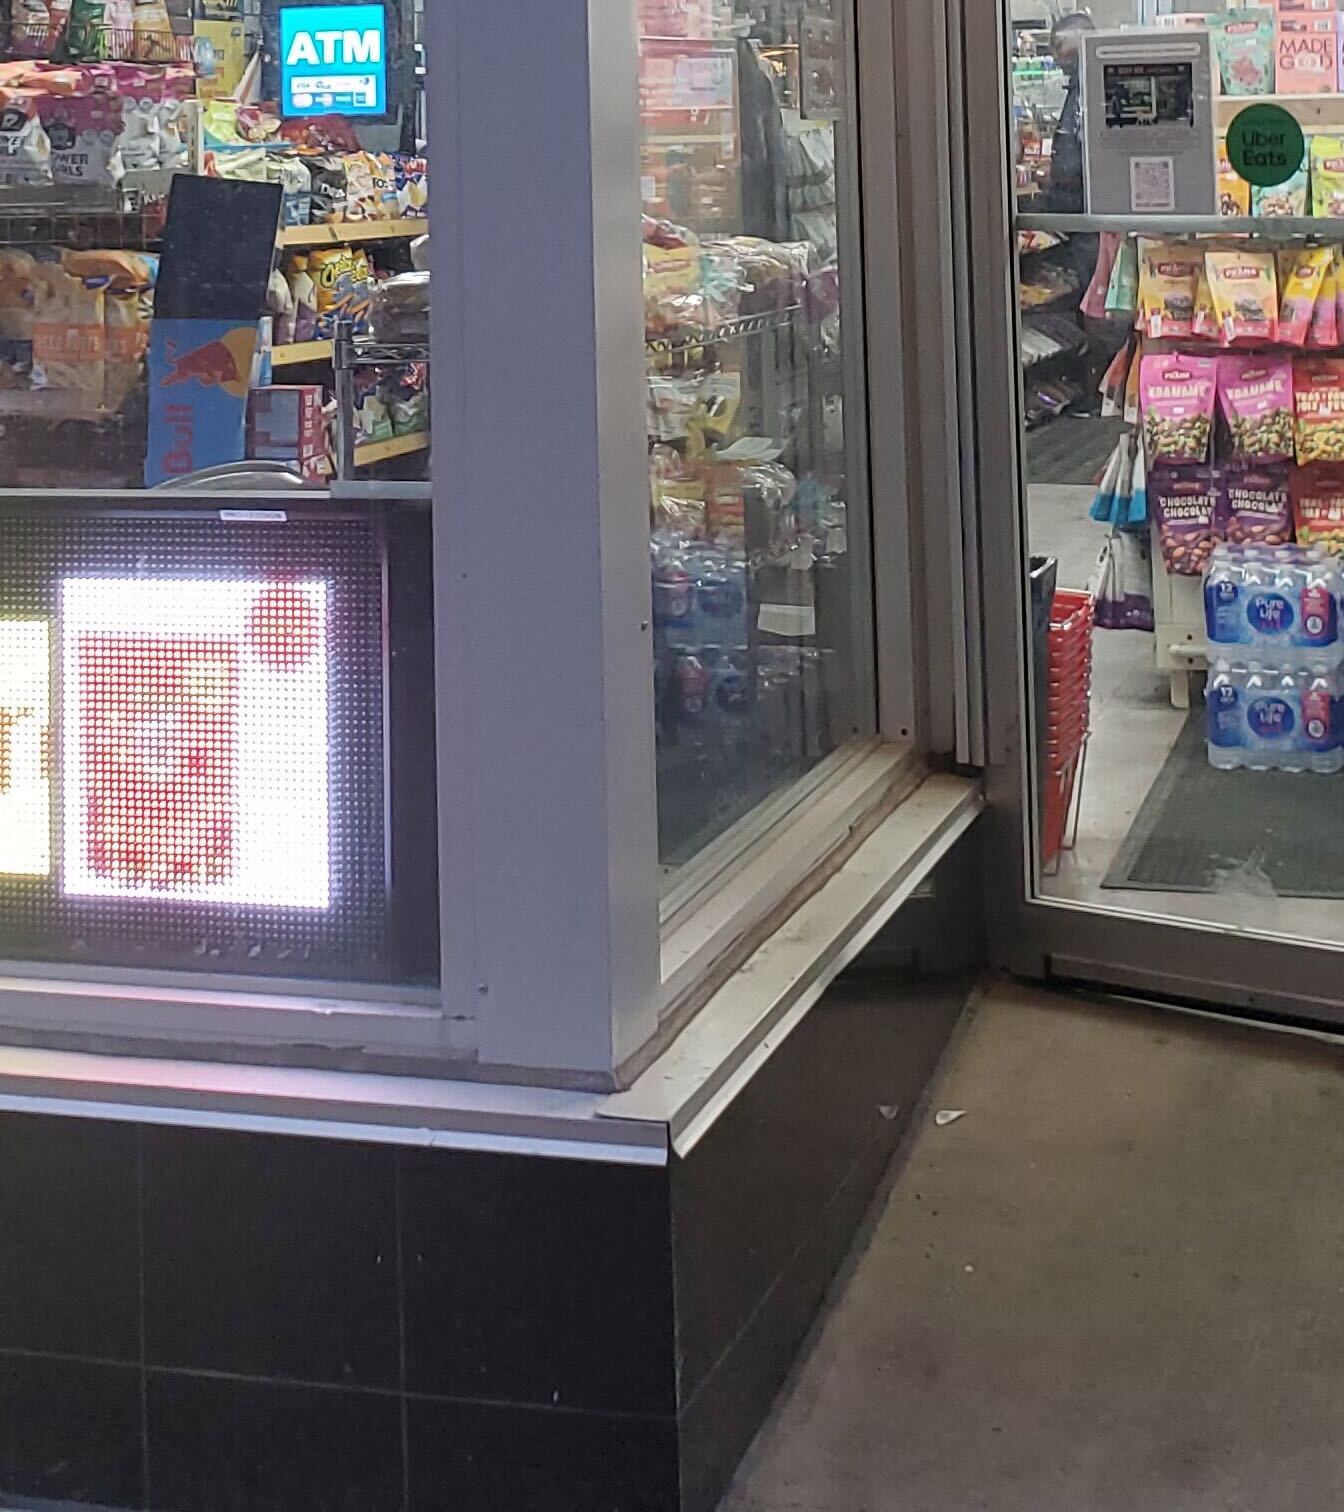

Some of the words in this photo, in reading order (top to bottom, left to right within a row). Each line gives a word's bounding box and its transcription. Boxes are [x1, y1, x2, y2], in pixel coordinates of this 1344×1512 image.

[286, 29, 381, 66] ATM
[1279, 38, 1332, 54] MADE
[1242, 129, 1287, 149] Uber
[1242, 150, 1289, 167] Eats
[163, 404, 193, 474] Bull
[1255, 598, 1284, 611] Pure
[1258, 607, 1280, 622] Life
[1256, 698, 1285, 713] Pure
[1259, 710, 1282, 724] Life
